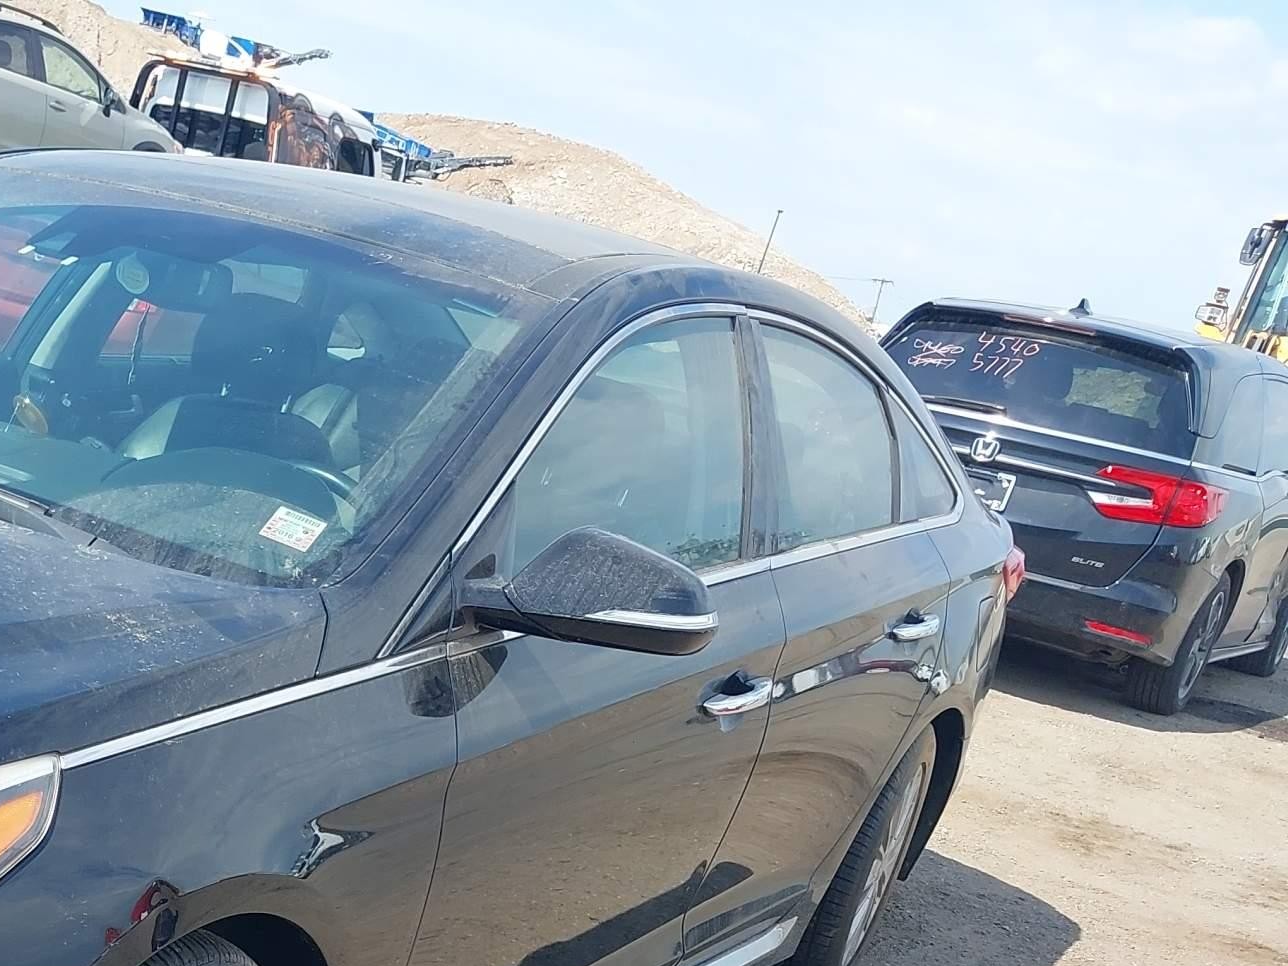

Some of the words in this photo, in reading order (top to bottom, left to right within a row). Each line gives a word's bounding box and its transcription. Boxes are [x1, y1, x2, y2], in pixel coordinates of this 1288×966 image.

[978, 331, 1040, 356] 4540
[968, 352, 1024, 378] 5777
[1071, 556, 1105, 568] ELITE
